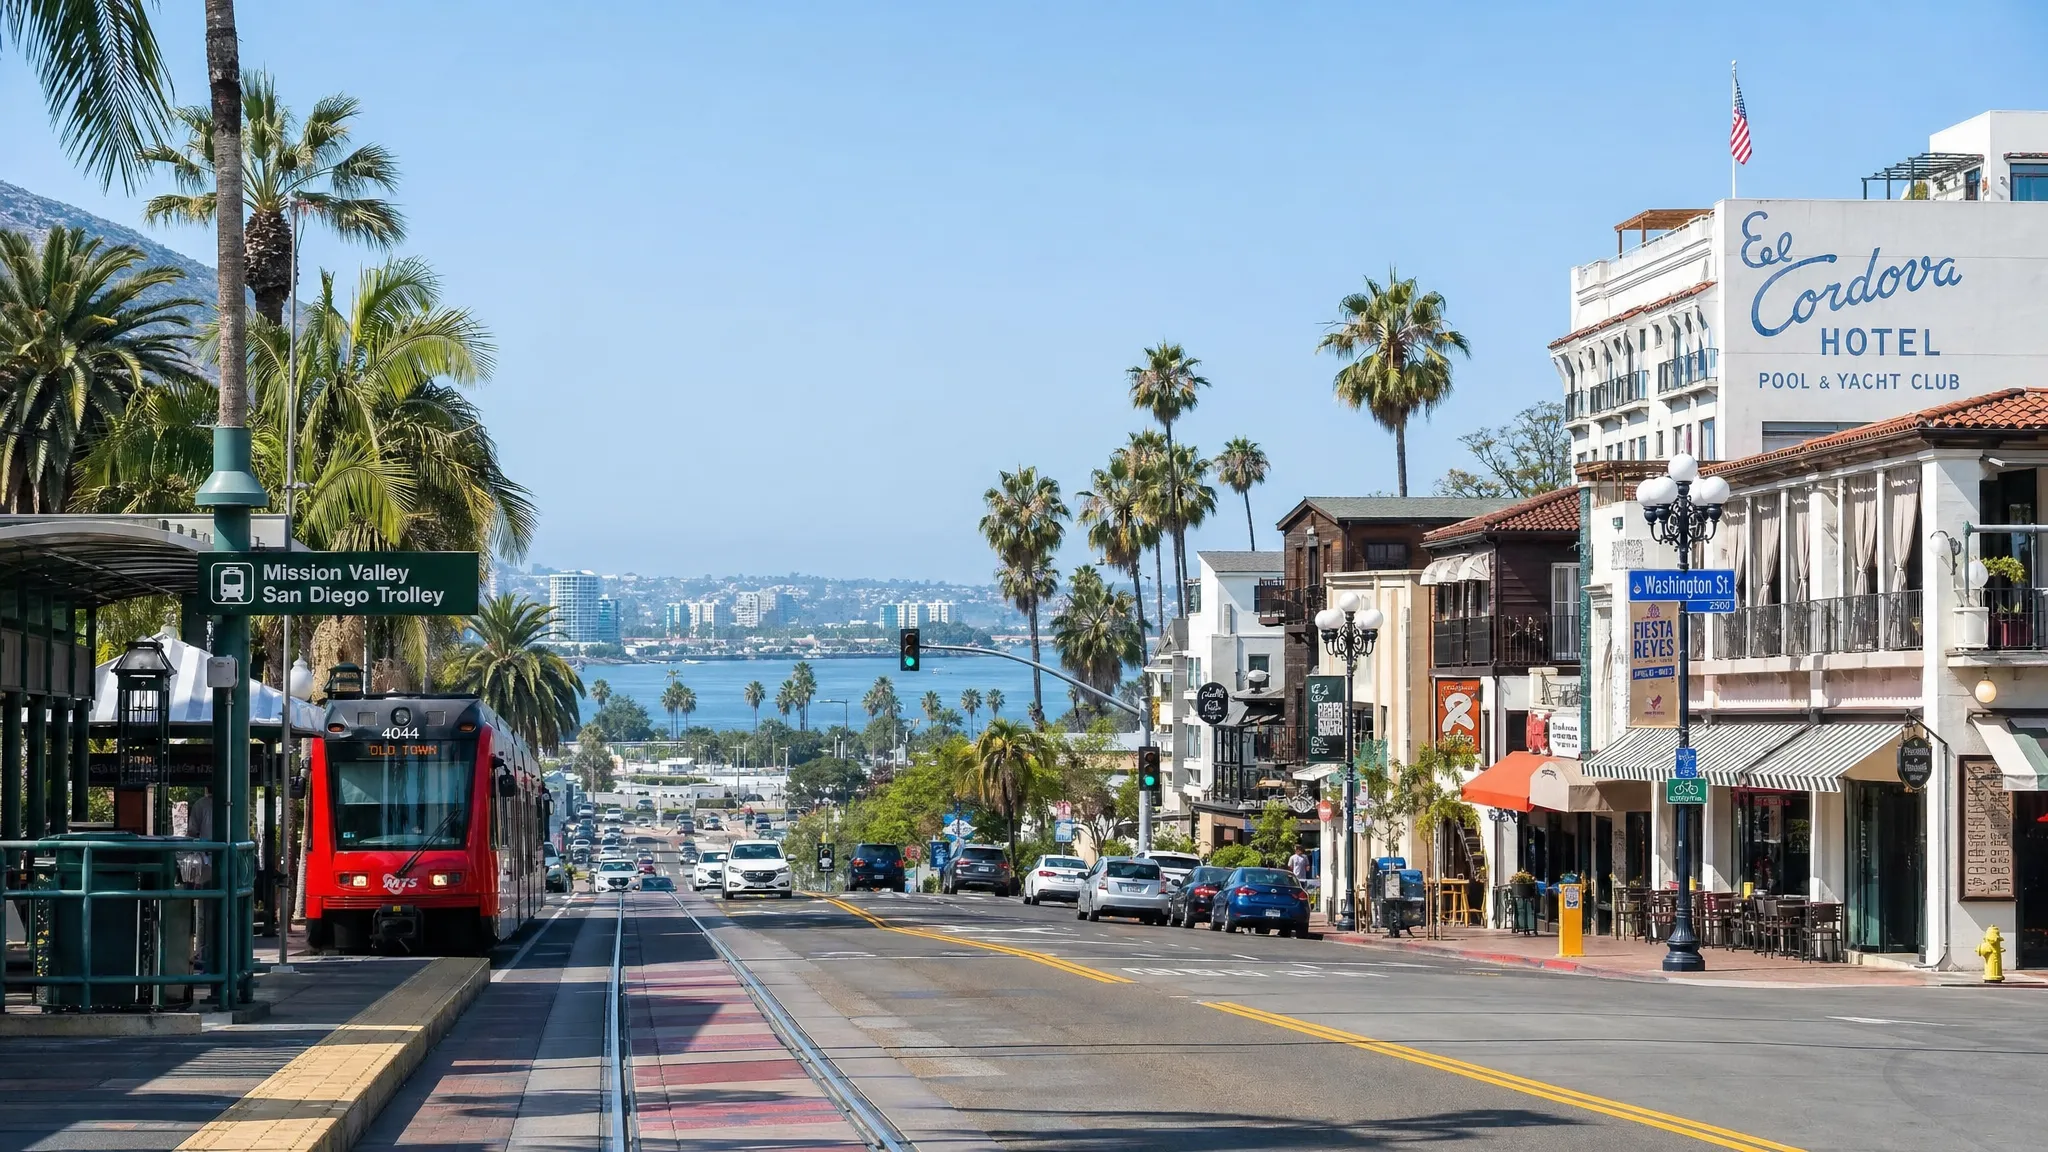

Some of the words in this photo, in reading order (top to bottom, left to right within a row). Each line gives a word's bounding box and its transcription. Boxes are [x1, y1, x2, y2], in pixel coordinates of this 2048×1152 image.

[1751, 246, 1963, 338] Cordova
[1821, 327, 1941, 357] HOTEL
[1759, 372, 1810, 390] POOL
[1819, 375, 1831, 390] &
[1837, 372, 1902, 390] YACHT
[1911, 373, 1961, 390] CLUB
[263, 564, 342, 581] Mission
[349, 564, 410, 584] Valley
[263, 586, 302, 604] San
[310, 586, 370, 607] Diego
[377, 586, 445, 607] Trolley
[1644, 575, 1712, 600] Washington
[1716, 574, 1732, 595] St.
[1709, 601, 1730, 611] 2500
[1633, 619, 1674, 640] FIESTA
[1633, 638, 1675, 659] REYES
[381, 727, 420, 740] 4044
[368, 745, 396, 756] OLD
[403, 744, 438, 756] TOWN
